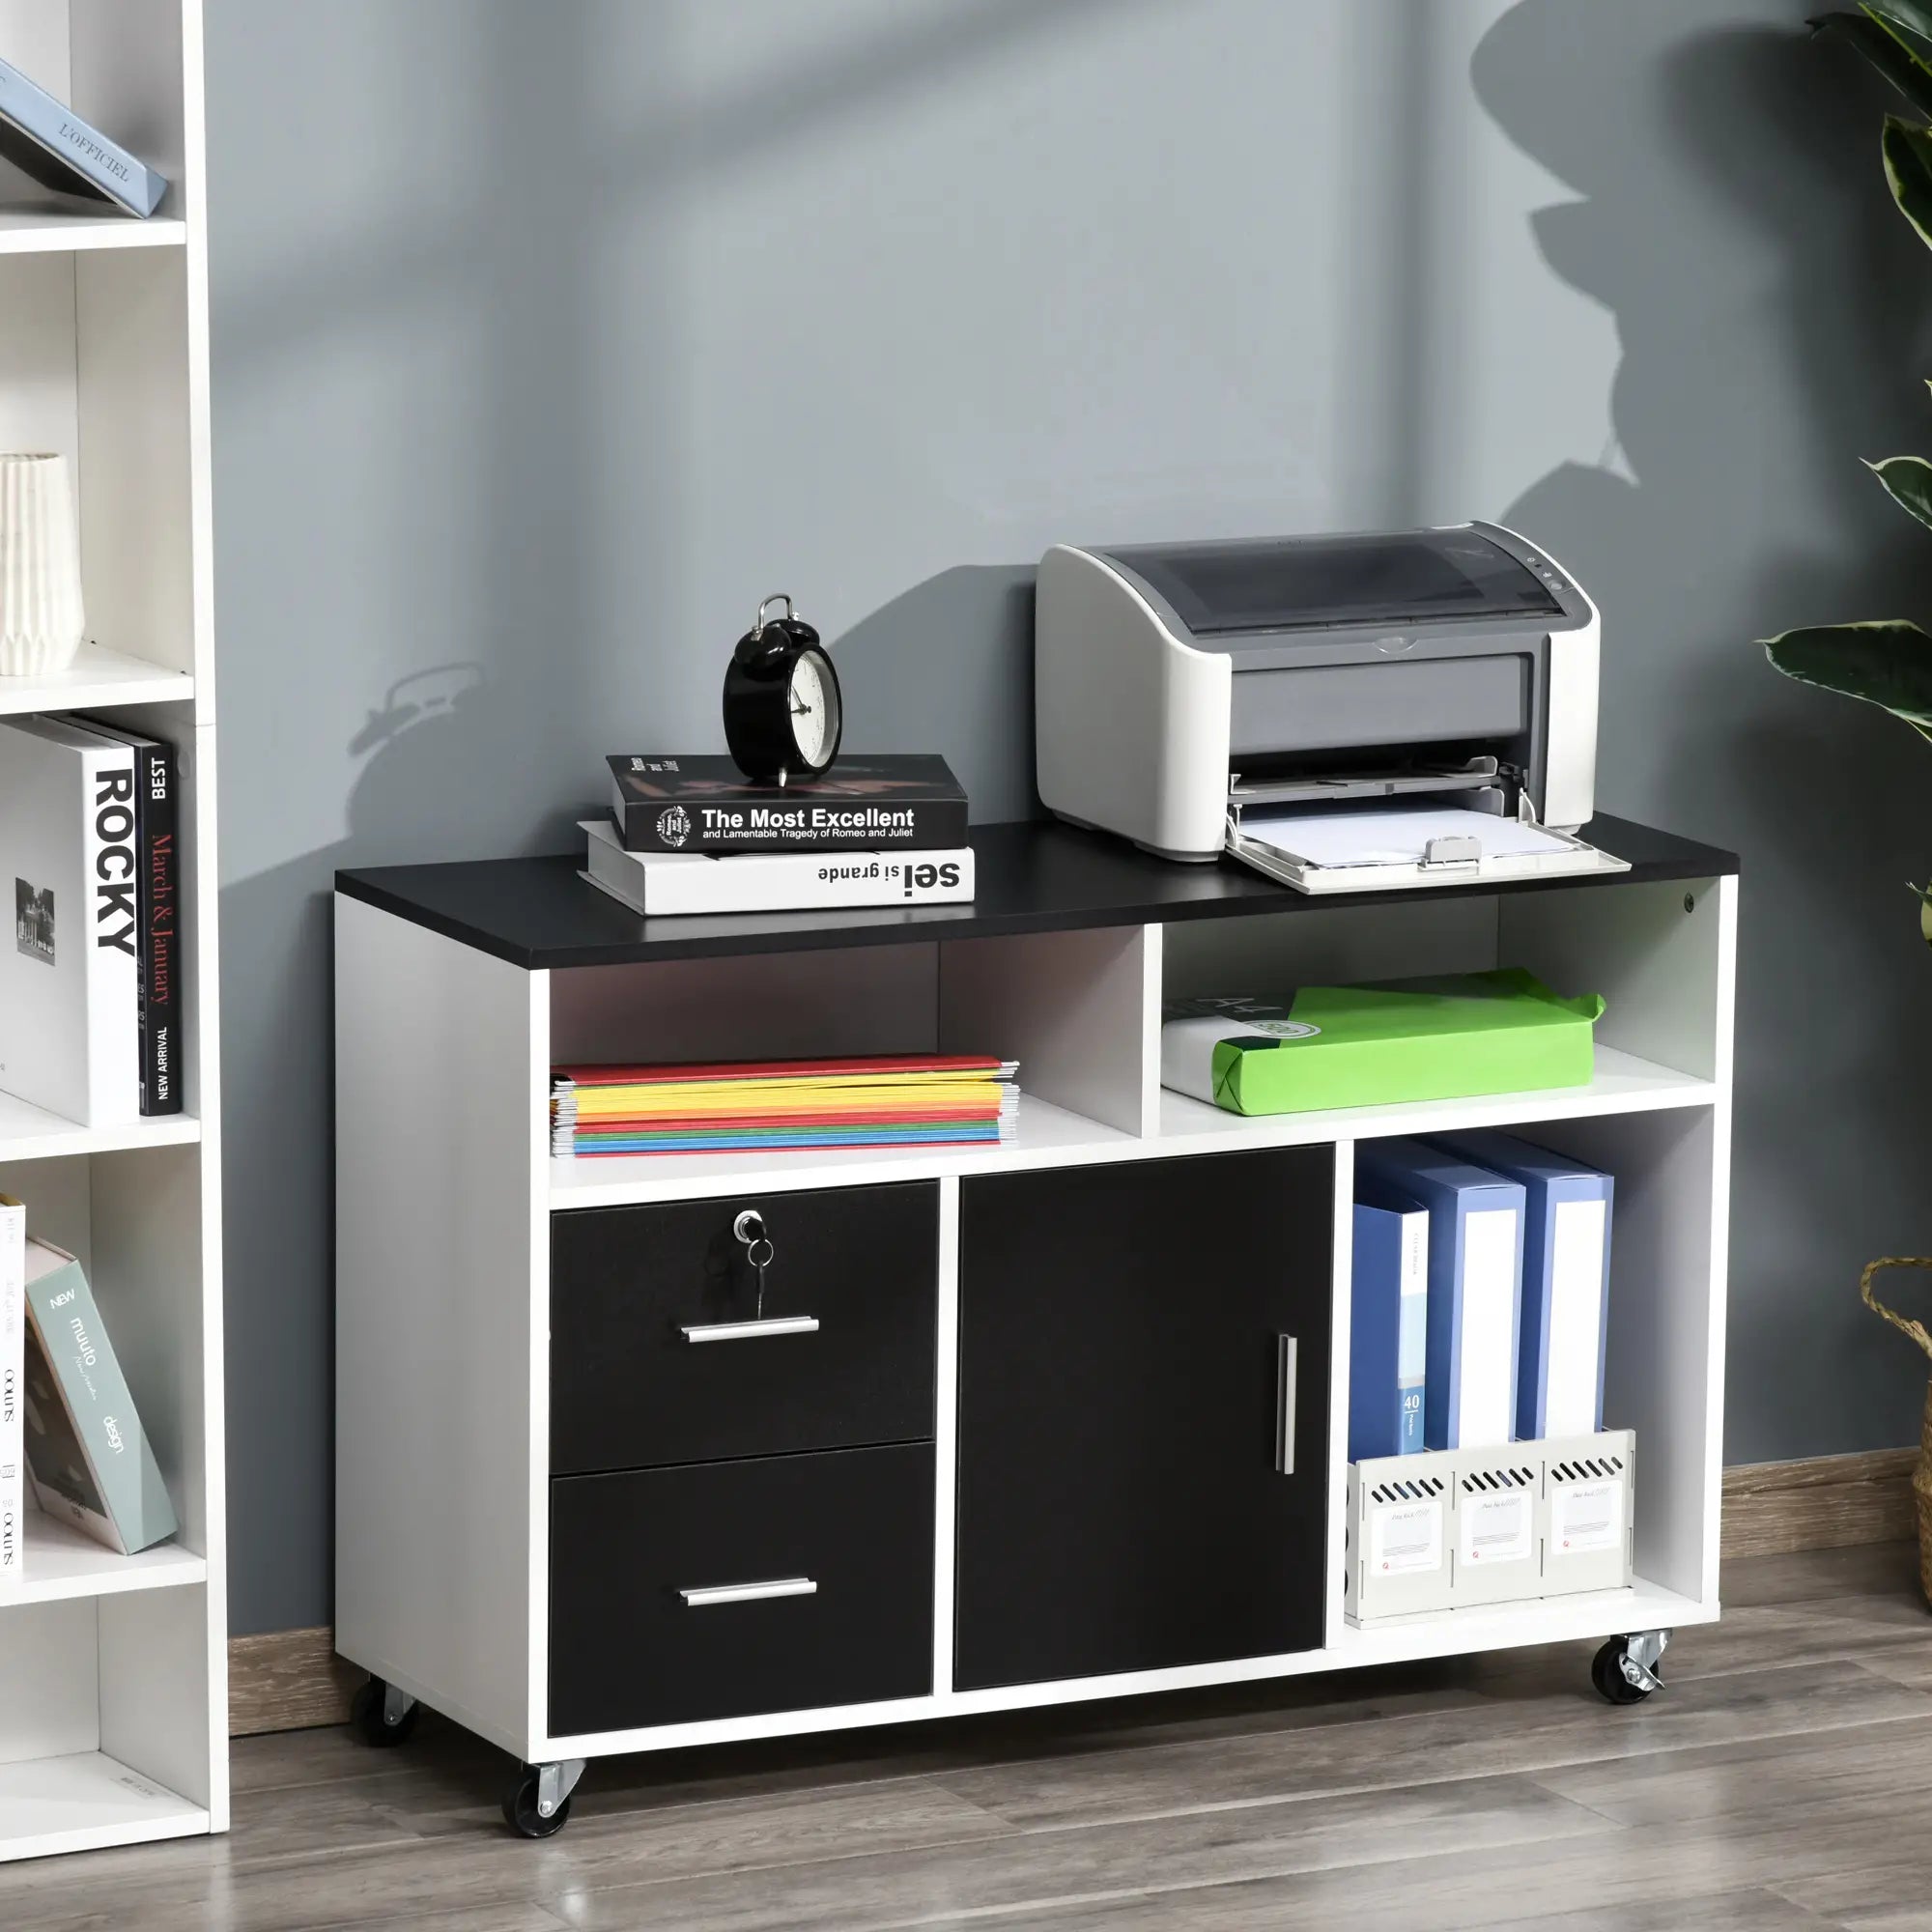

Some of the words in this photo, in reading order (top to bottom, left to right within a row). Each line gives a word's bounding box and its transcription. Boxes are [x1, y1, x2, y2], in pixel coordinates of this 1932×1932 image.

[59, 123, 129, 183] L'OFFICIEL
[151, 757, 166, 800] BEST
[701, 810, 744, 828] The
[751, 809, 806, 828] Most
[811, 808, 915, 828] Excellent
[702, 829, 721, 838] and
[724, 829, 778, 838] Lamentable
[780, 828, 818, 840] Tragedy
[820, 828, 831, 838] of
[832, 828, 867, 838] Romeo
[868, 828, 887, 838] and
[888, 828, 914, 838] Juliet
[96, 768, 136, 957] ROCKY
[152, 834, 174, 899] March
[818, 862, 880, 884] grande
[885, 866, 899, 881] si
[904, 863, 960, 897] sei
[154, 905, 174, 923] &
[151, 928, 173, 1005] January
[156, 1026, 168, 1073] ARRIVAL
[157, 1074, 169, 1100] NEW
[50, 1288, 76, 1309] NEW
[70, 1317, 97, 1366] muuto
[1404, 1394, 1420, 1409] 40
[102, 1415, 125, 1455] design
